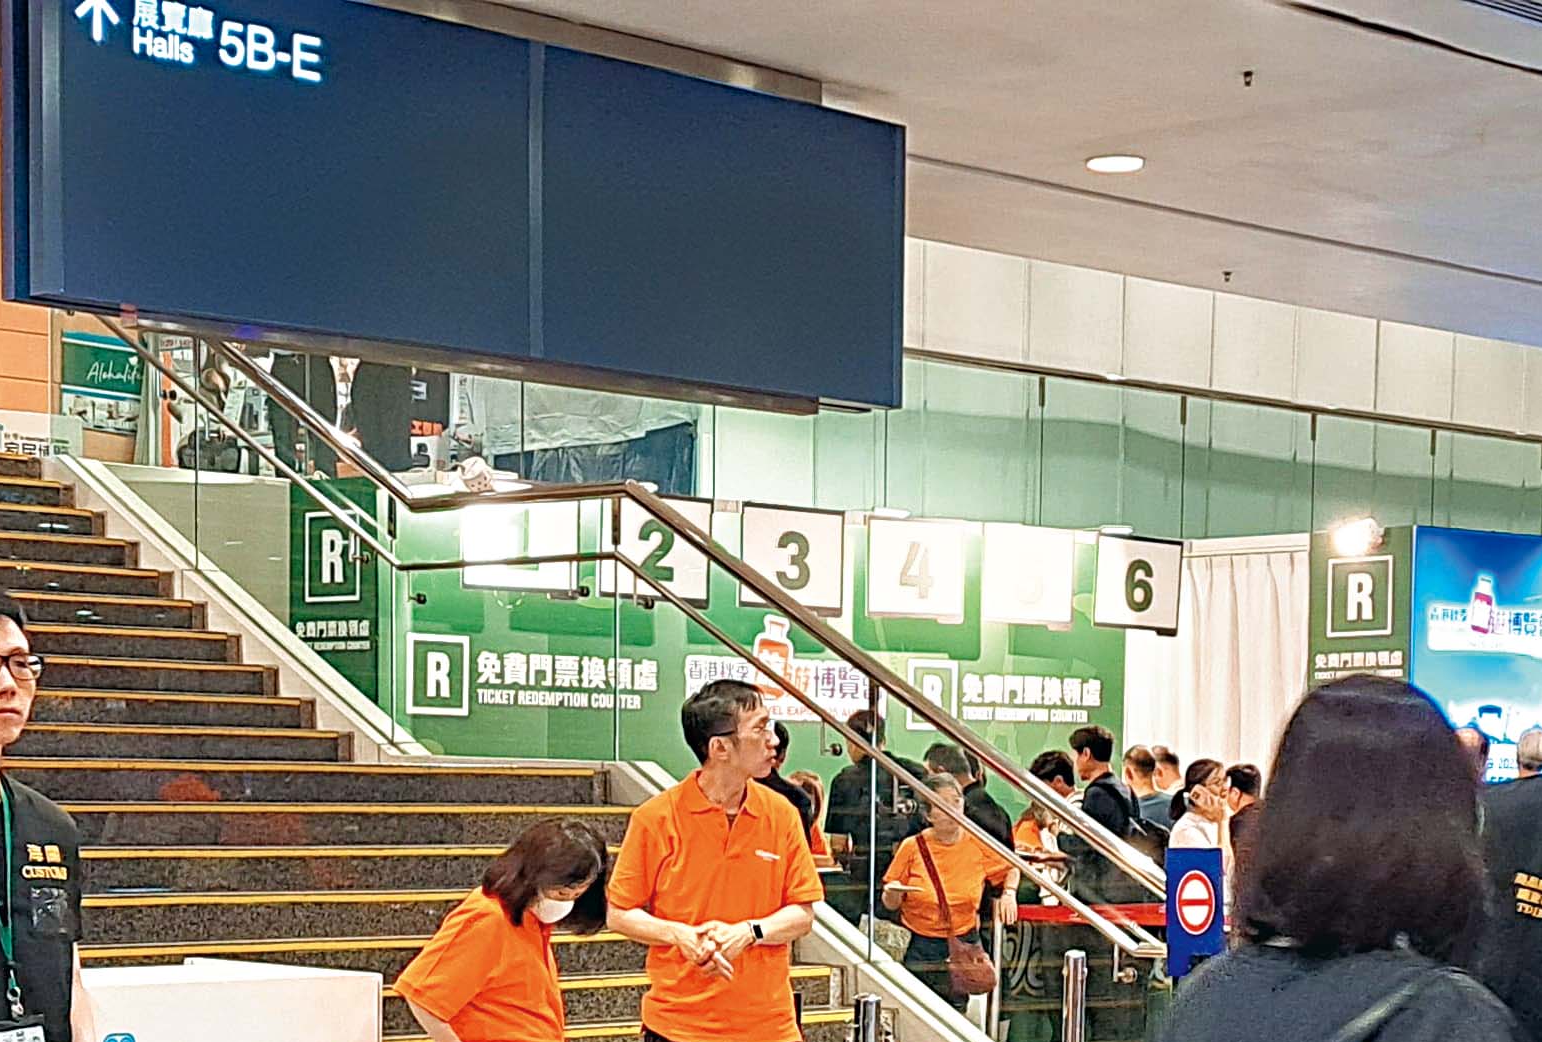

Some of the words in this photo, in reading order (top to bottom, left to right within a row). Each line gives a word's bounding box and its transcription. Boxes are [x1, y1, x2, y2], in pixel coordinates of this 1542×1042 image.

[133, 26, 194, 63] Halls
[219, 20, 322, 82] 5B-E
[322, 529, 344, 583] R
[638, 519, 674, 582] 2
[775, 530, 810, 590] 3
[899, 542, 934, 599] 4
[1125, 559, 1154, 612] 6
[1346, 573, 1374, 621] R
[426, 651, 451, 698] R
[476, 651, 658, 691] 免費門票換領處
[923, 674, 943, 707] R
[477, 688, 514, 705] TICKET
[517, 690, 588, 708] REDEMPTION
[590, 695, 642, 710] COUTER
